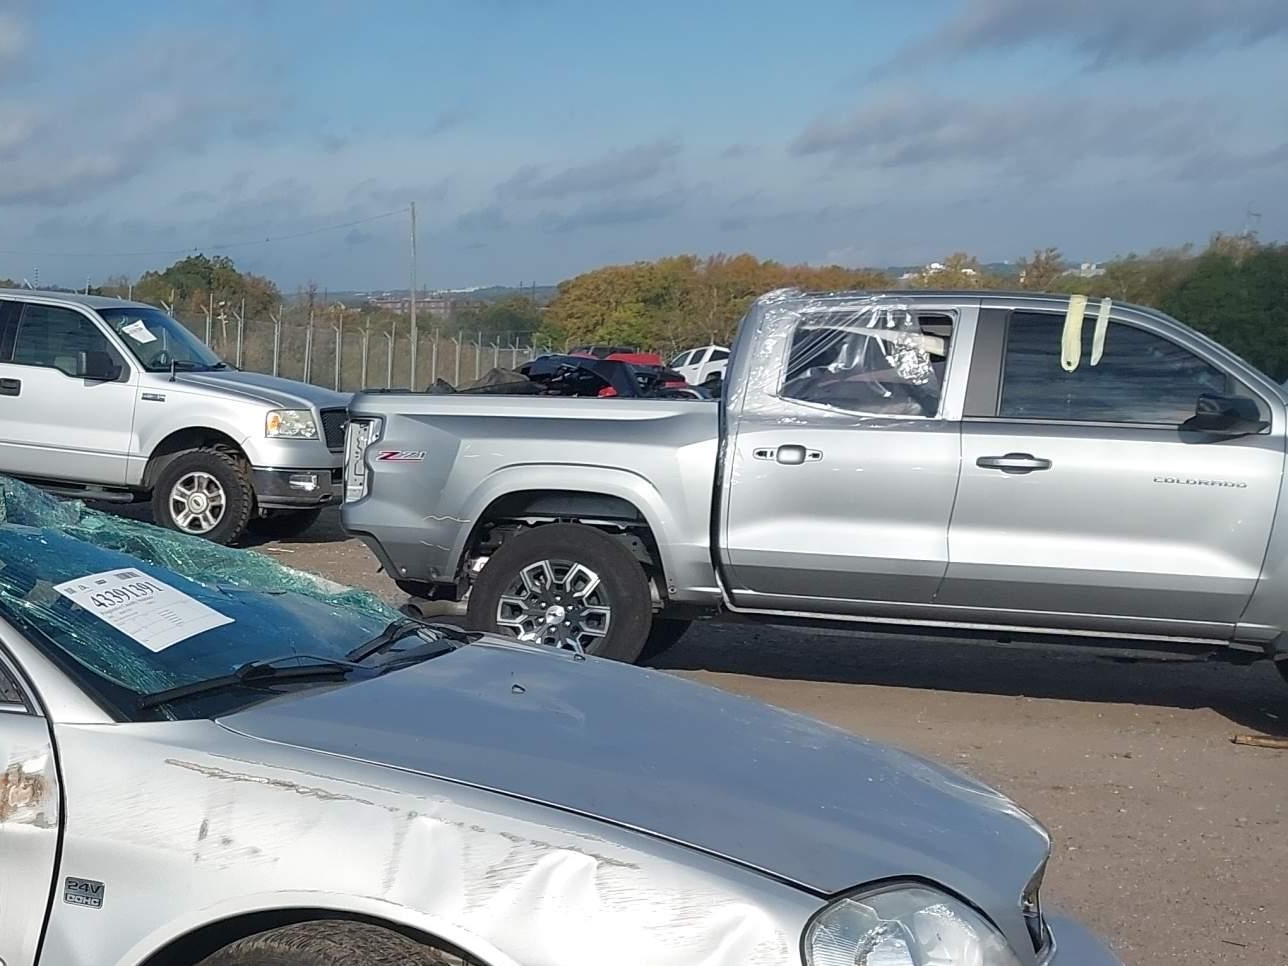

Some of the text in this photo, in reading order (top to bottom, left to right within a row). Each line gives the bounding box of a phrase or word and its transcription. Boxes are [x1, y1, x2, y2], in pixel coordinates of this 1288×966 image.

[376, 450, 426, 462] Z71
[1153, 477, 1247, 488] COLORADO
[90, 581, 164, 608] 43391391
[67, 880, 104, 893] 24V
[66, 893, 100, 906] DOHC
